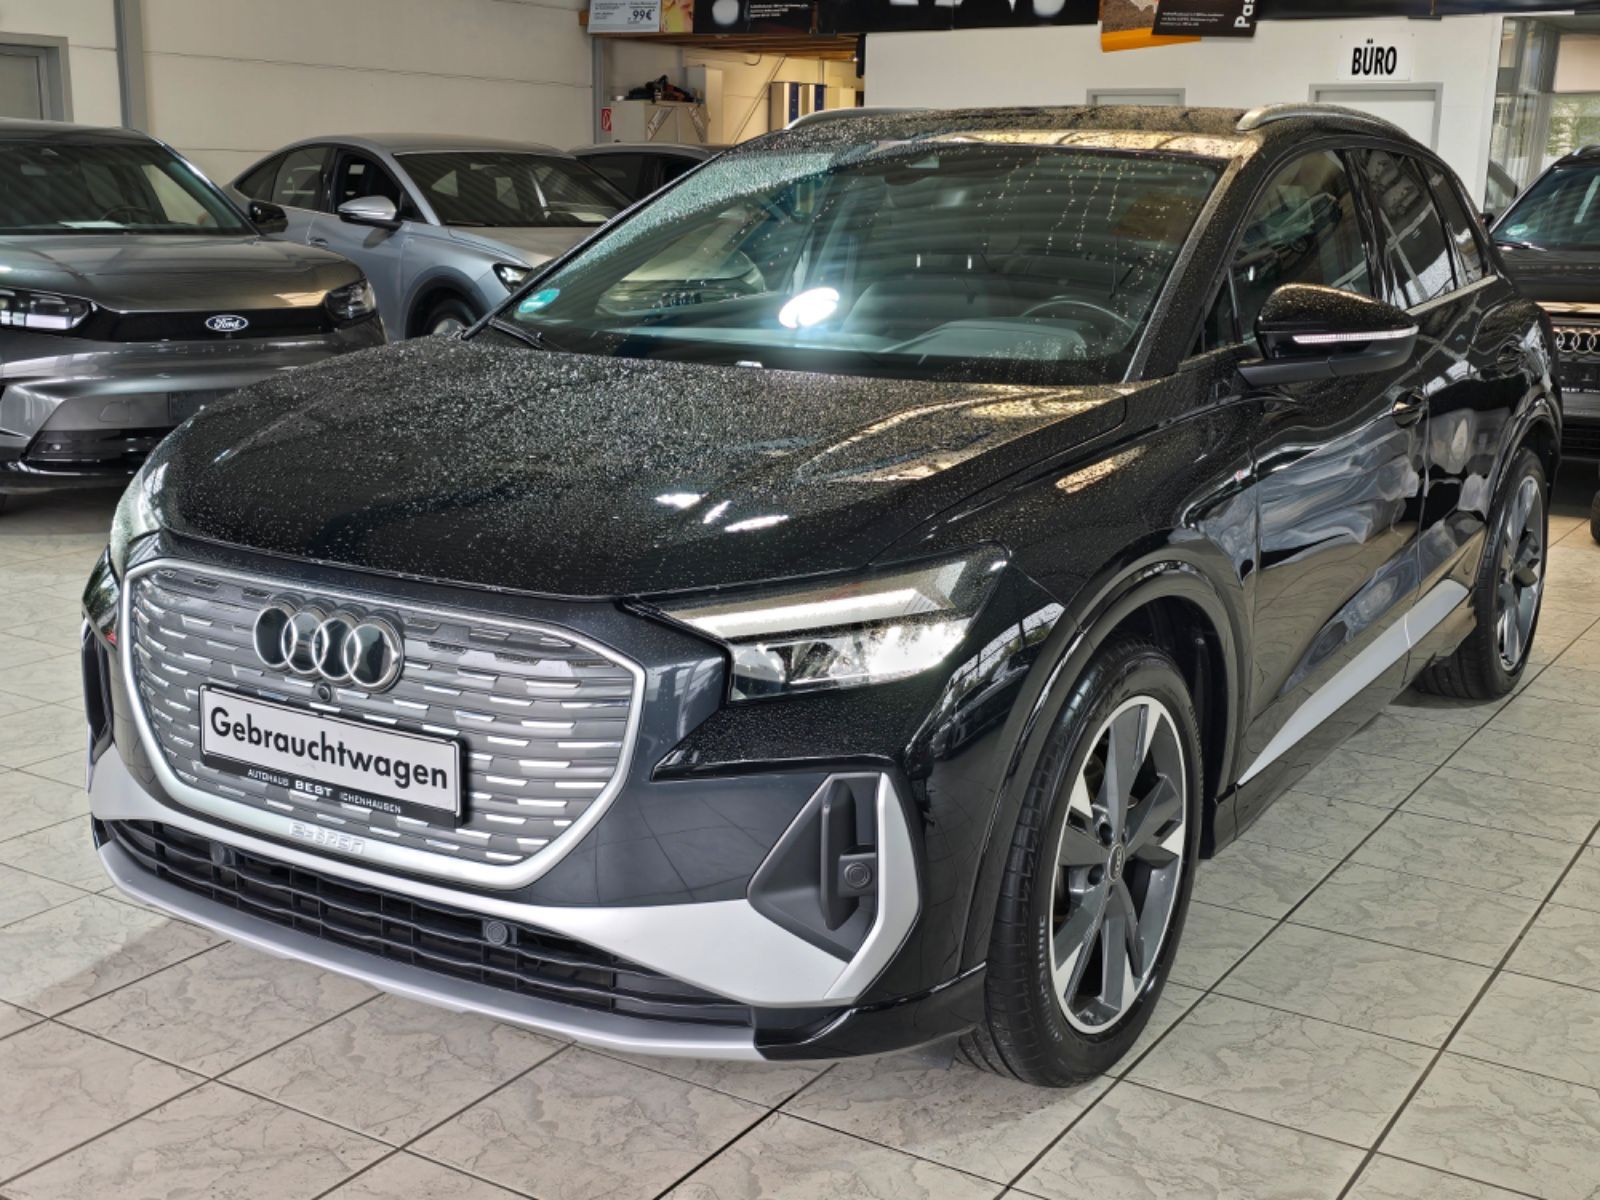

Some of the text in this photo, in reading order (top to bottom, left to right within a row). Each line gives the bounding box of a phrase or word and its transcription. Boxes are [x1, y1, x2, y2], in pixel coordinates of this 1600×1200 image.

[1352, 38, 1397, 75] BÜRO
[210, 706, 449, 789] Gebrauchtwagen
[247, 768, 290, 788] AUTOHAUS
[295, 779, 334, 798] BEST
